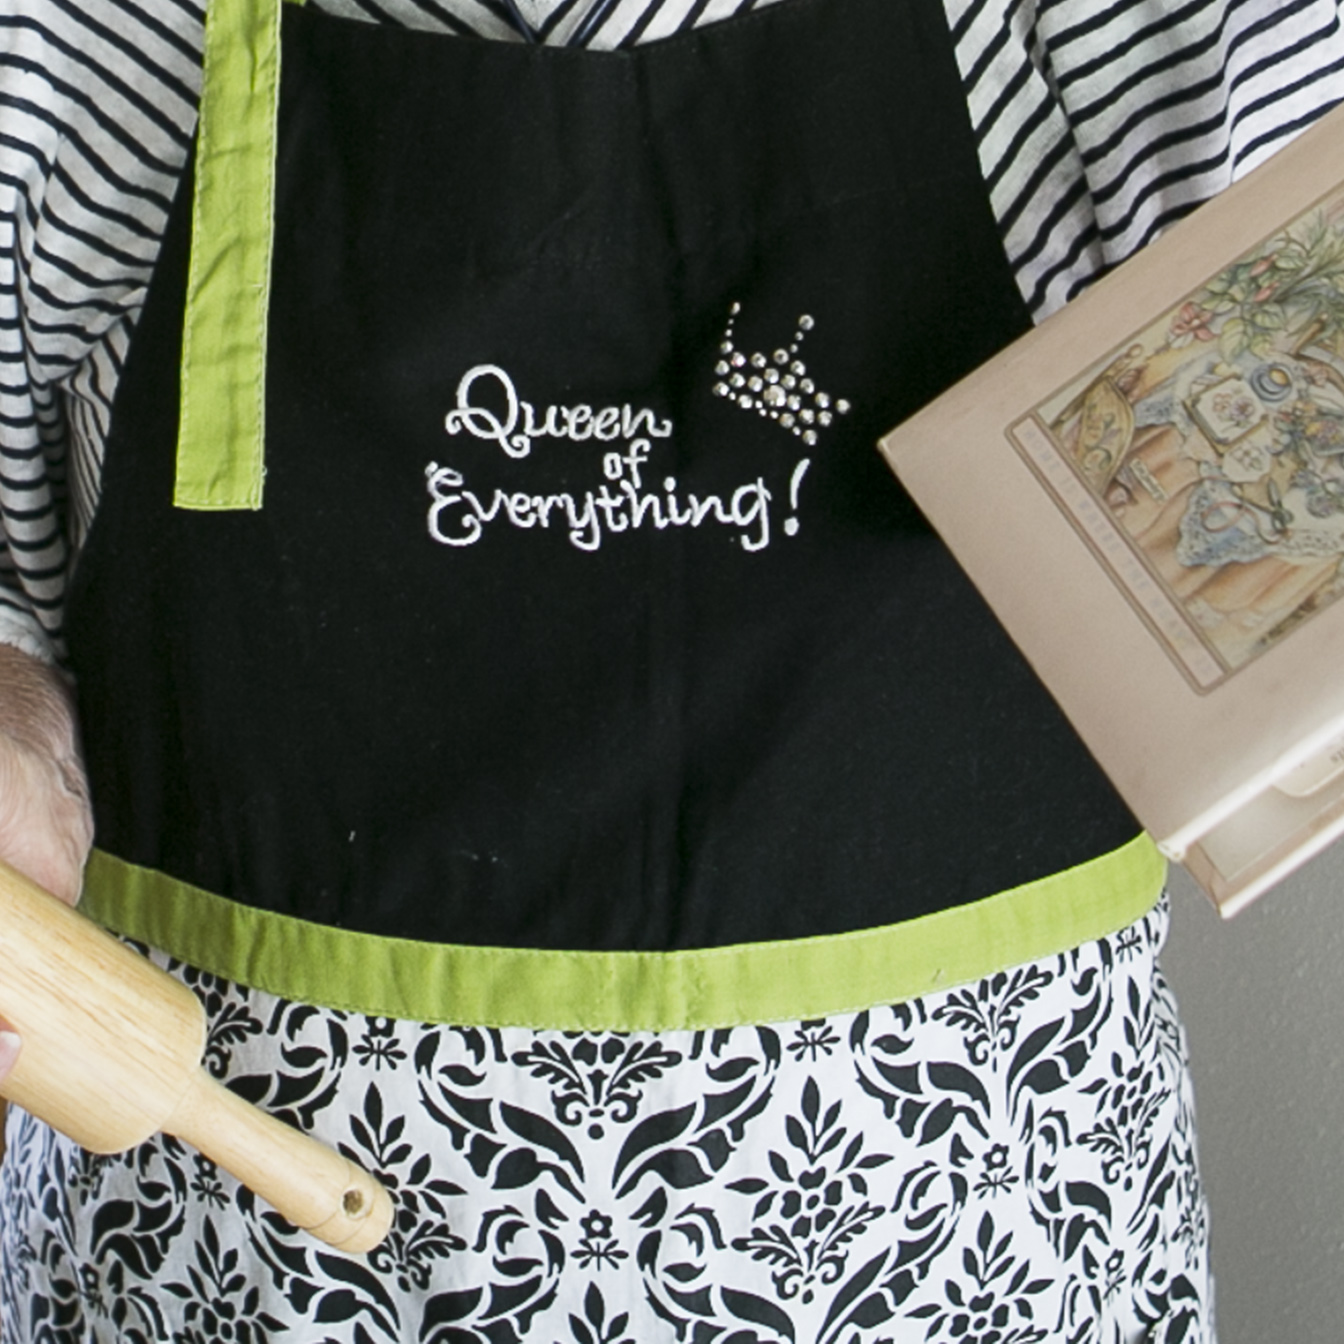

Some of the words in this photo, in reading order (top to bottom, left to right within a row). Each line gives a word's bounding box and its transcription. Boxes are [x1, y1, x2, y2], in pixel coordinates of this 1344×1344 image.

[445, 364, 672, 457] Queen
[425, 459, 811, 551] Everything!
[604, 438, 651, 488] of
